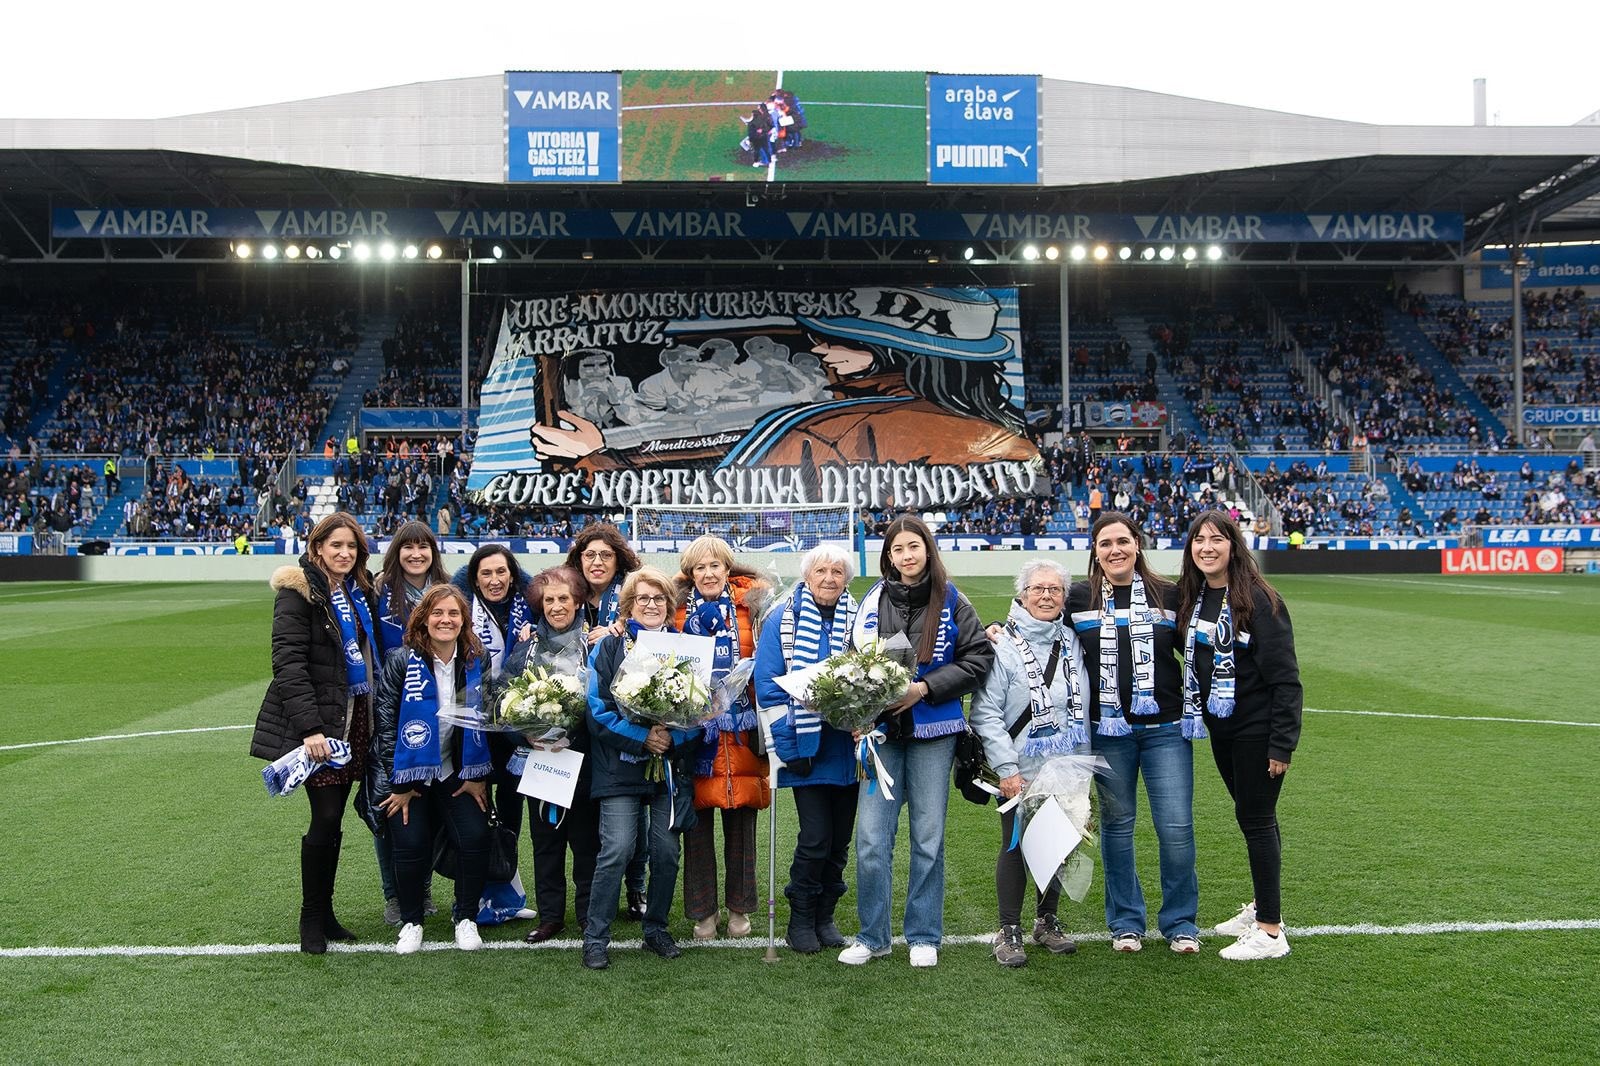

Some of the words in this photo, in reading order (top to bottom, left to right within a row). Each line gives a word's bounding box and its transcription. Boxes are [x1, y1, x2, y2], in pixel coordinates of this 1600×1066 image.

[532, 91, 613, 110] AMBAR
[945, 85, 997, 103] araba
[964, 102, 1014, 120] álava
[527, 131, 586, 148] VITORIA
[527, 148, 586, 166] GASTEIZ
[936, 145, 1004, 168] PUMA
[532, 166, 556, 177] green
[557, 165, 586, 177] capital
[100, 210, 211, 236] AMBAR
[279, 210, 393, 236] AMBAR
[460, 210, 570, 237] AMBAR
[635, 211, 746, 238] AMBAR
[811, 211, 921, 238] AMBAR
[987, 213, 1094, 239] AMBAR
[1157, 214, 1265, 240] AMBAR
[1331, 214, 1439, 240] AMBAR
[508, 294, 569, 329] URE
[704, 288, 860, 317] URRATSAK
[1522, 408, 1579, 423] GRUPO
[1581, 407, 1600, 423] EL
[484, 470, 584, 505] GURE
[586, 466, 808, 506] NORTASUNA
[820, 460, 1036, 508] DEFENDATU
[1488, 529, 1530, 543] LEA
[1539, 528, 1582, 542] LEA
[1446, 549, 1530, 571] LALIGA
[715, 646, 729, 656] 100
[533, 762, 553, 774] ZUTAZ
